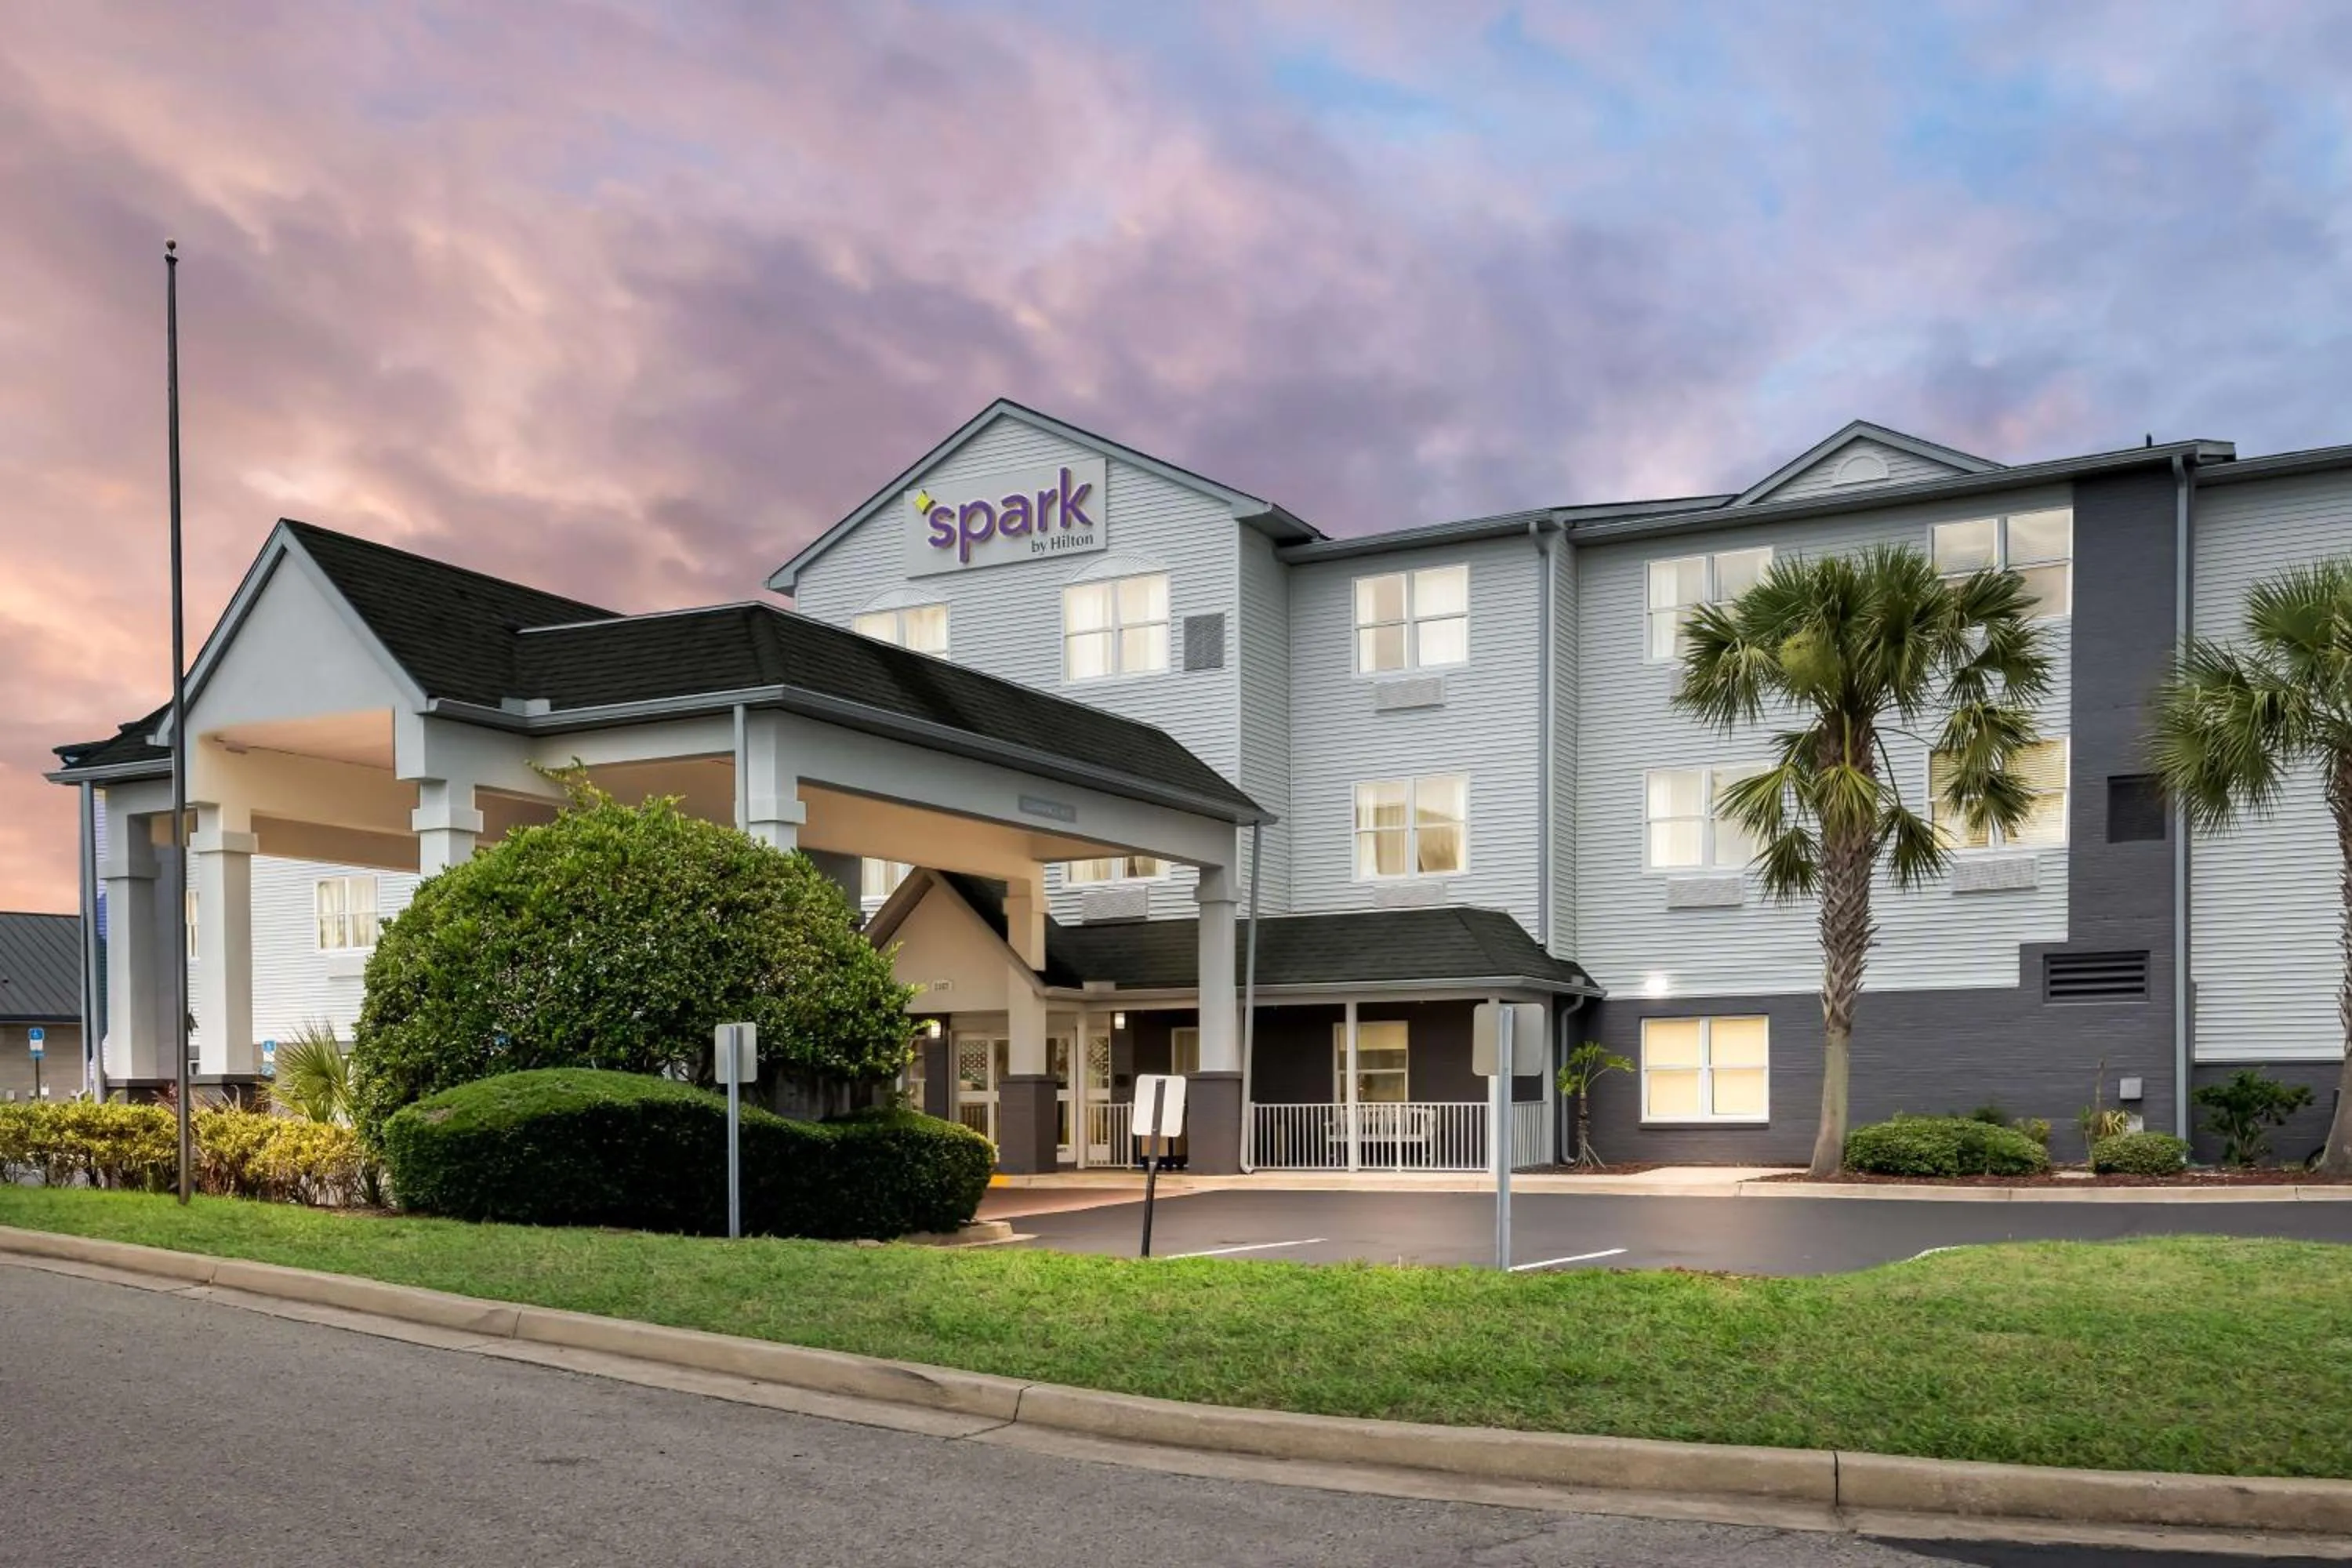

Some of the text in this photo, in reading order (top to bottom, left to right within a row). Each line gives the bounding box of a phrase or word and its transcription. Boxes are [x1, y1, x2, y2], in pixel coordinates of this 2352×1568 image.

[928, 467, 1094, 564] spark
[1031, 534, 1094, 555] by Hilton
